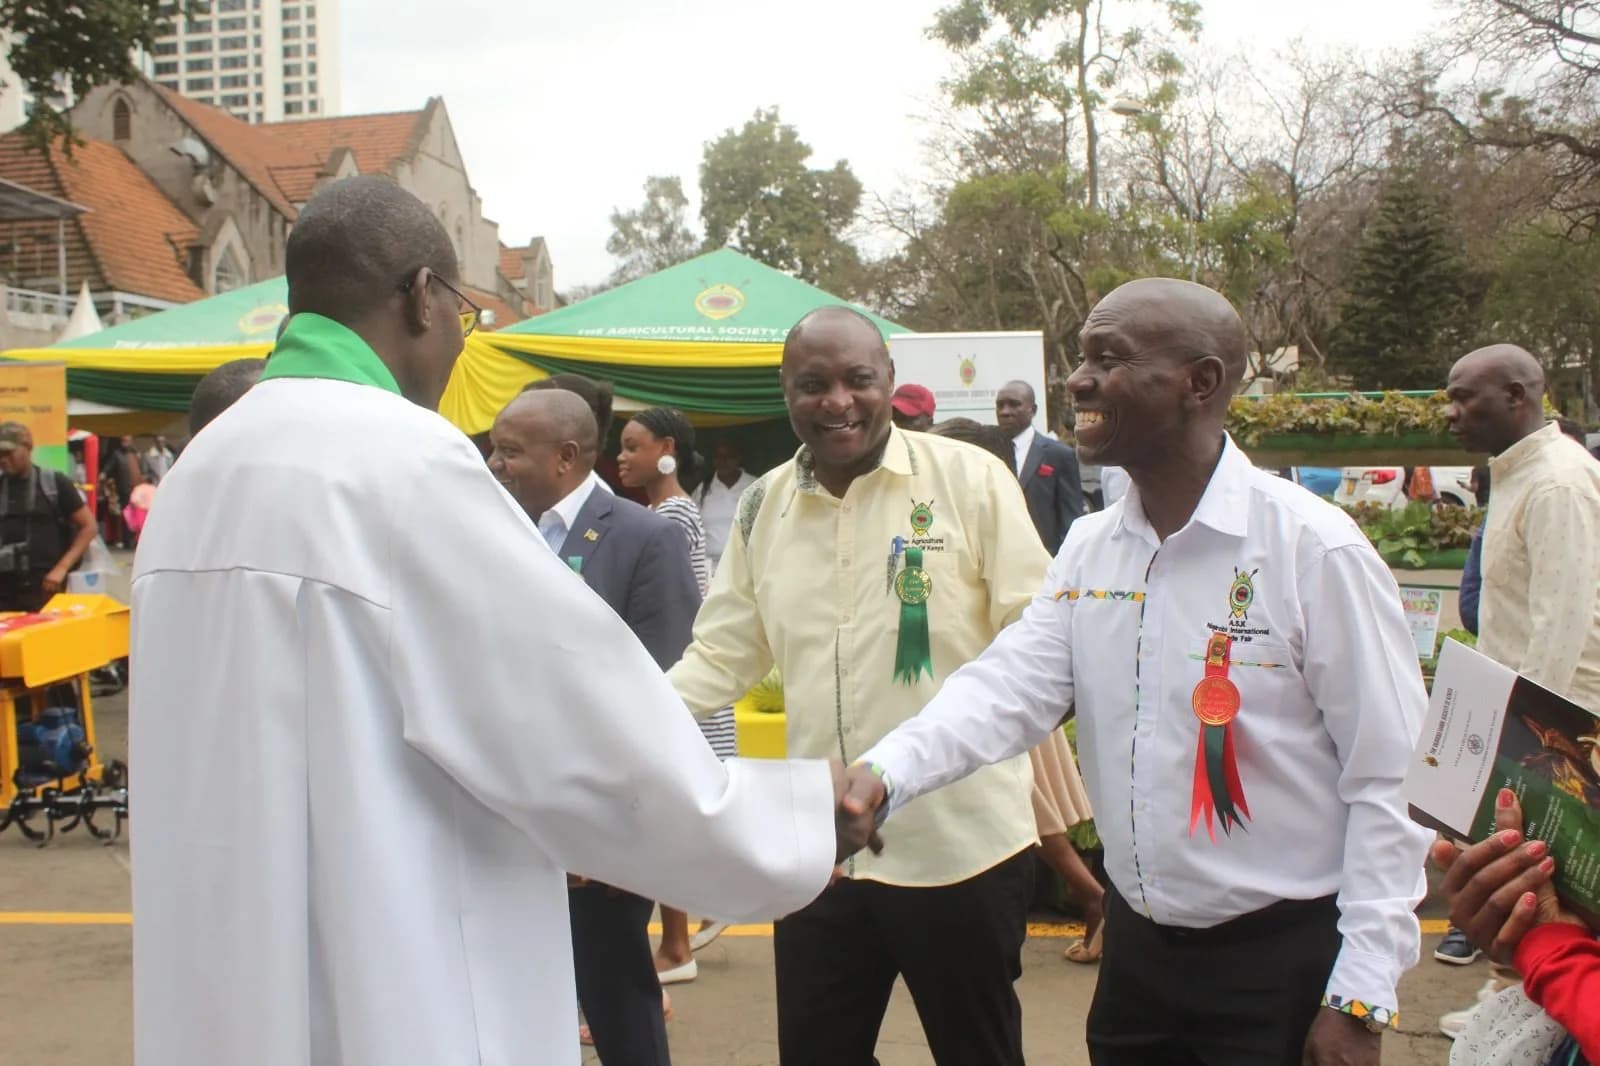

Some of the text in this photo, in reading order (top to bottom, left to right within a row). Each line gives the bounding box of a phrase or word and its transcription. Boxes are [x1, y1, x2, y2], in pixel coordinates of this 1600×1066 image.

[607, 326, 713, 336] AGRICULTURAL
[718, 327, 778, 336] SOCIETY
[1230, 627, 1269, 635] International
